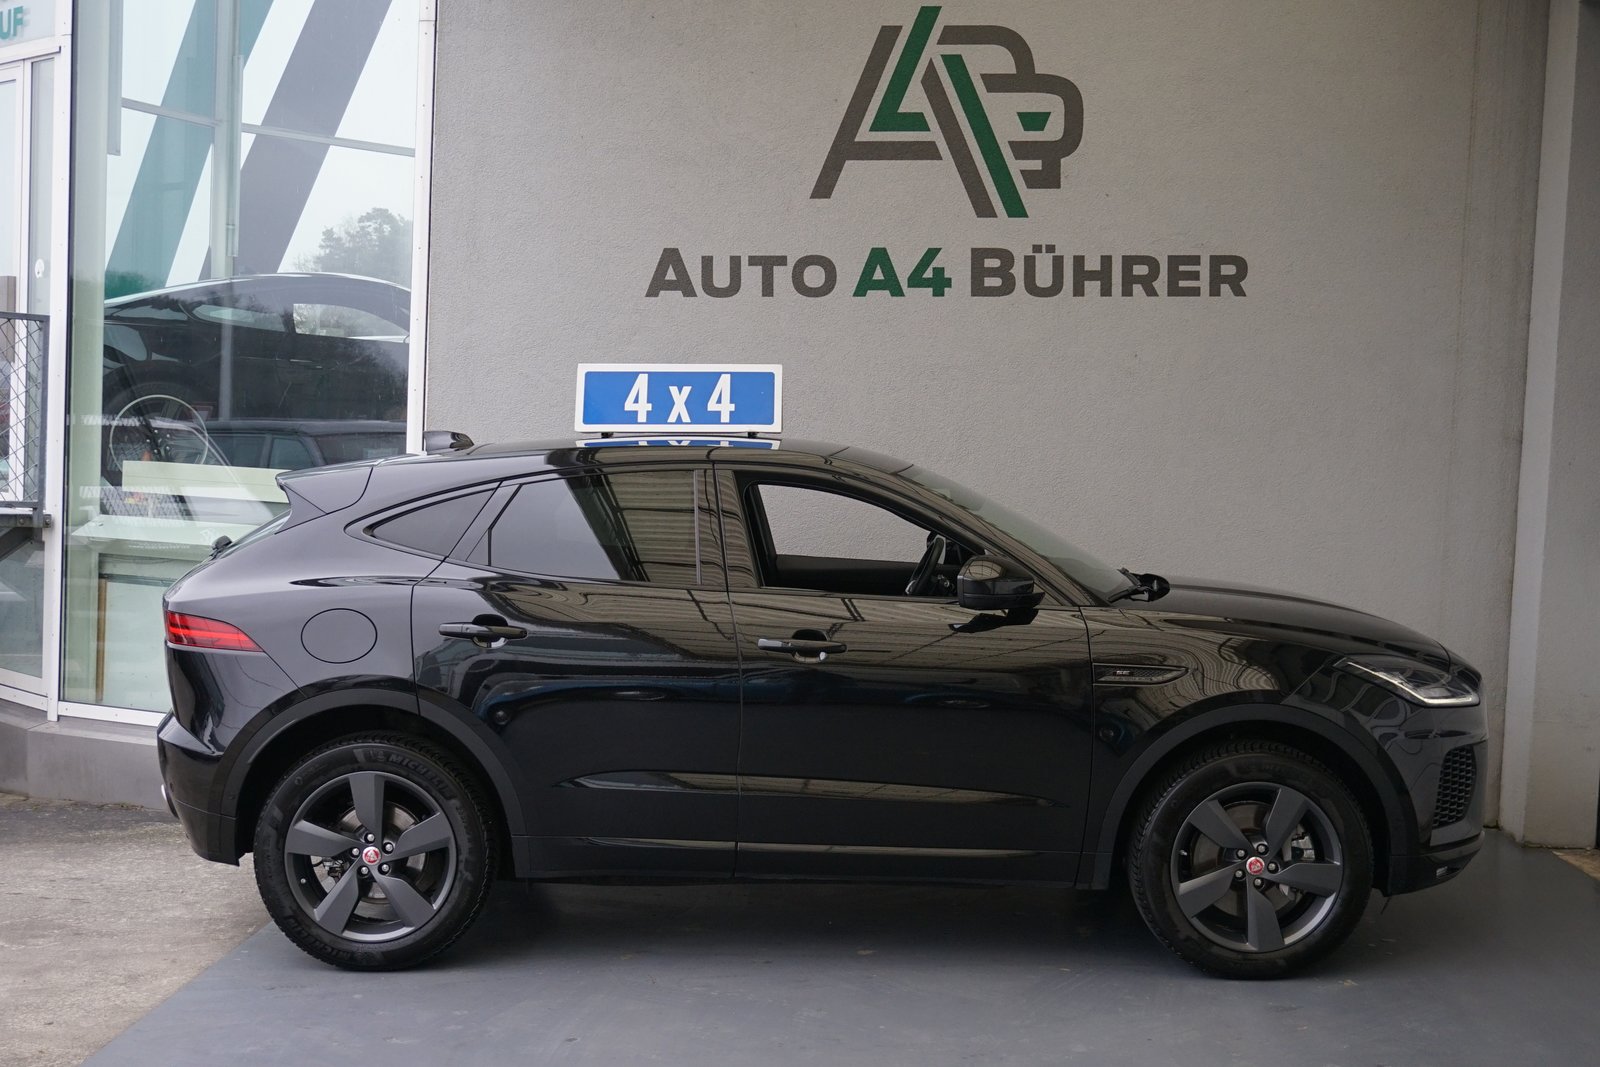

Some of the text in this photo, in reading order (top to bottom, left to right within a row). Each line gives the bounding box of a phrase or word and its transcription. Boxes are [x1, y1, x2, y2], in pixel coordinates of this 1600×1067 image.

[645, 244, 1248, 298] AUTO A4 BÜHRER
[624, 373, 652, 423] 4
[707, 373, 735, 423] 4
